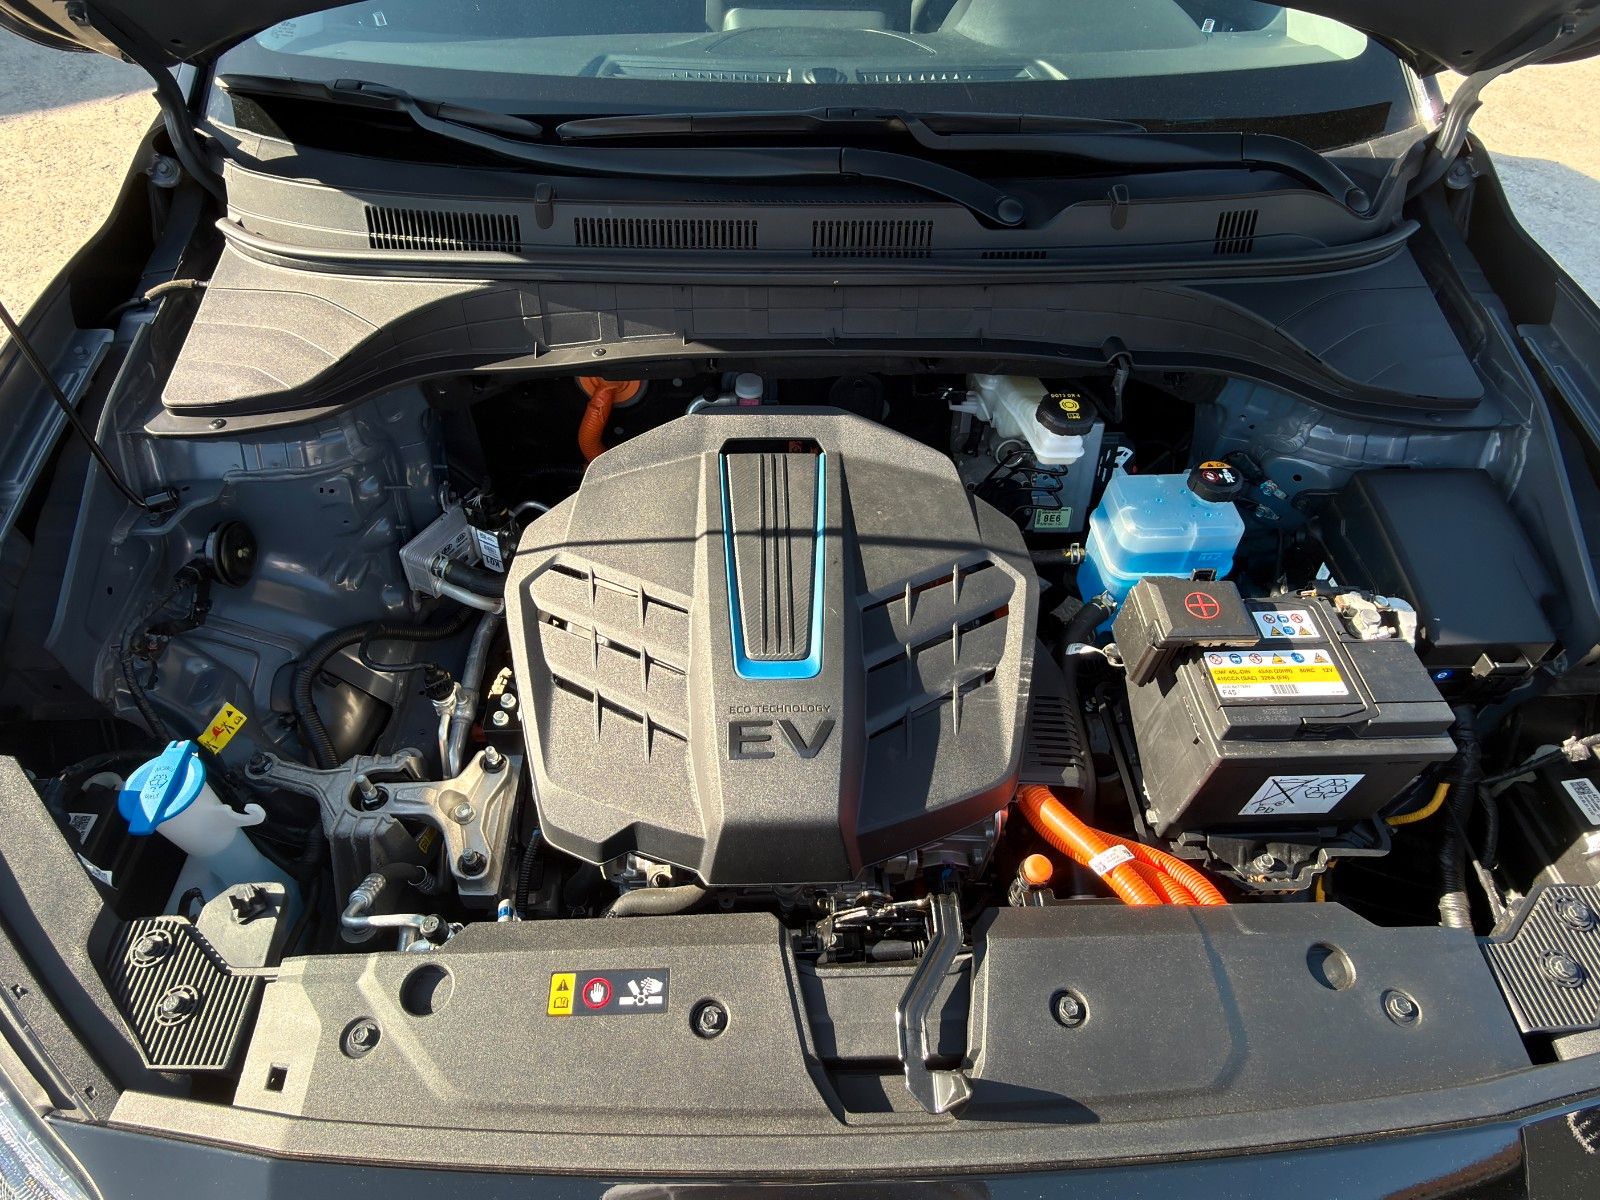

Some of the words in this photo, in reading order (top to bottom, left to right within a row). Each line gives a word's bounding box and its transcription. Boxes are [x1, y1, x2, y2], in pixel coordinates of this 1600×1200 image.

[1043, 514, 1061, 523] 8E6
[729, 705, 752, 714] ECO
[755, 704, 831, 714] TECHNOLOGY
[727, 719, 837, 761] EV
[1254, 806, 1275, 814] Pb
